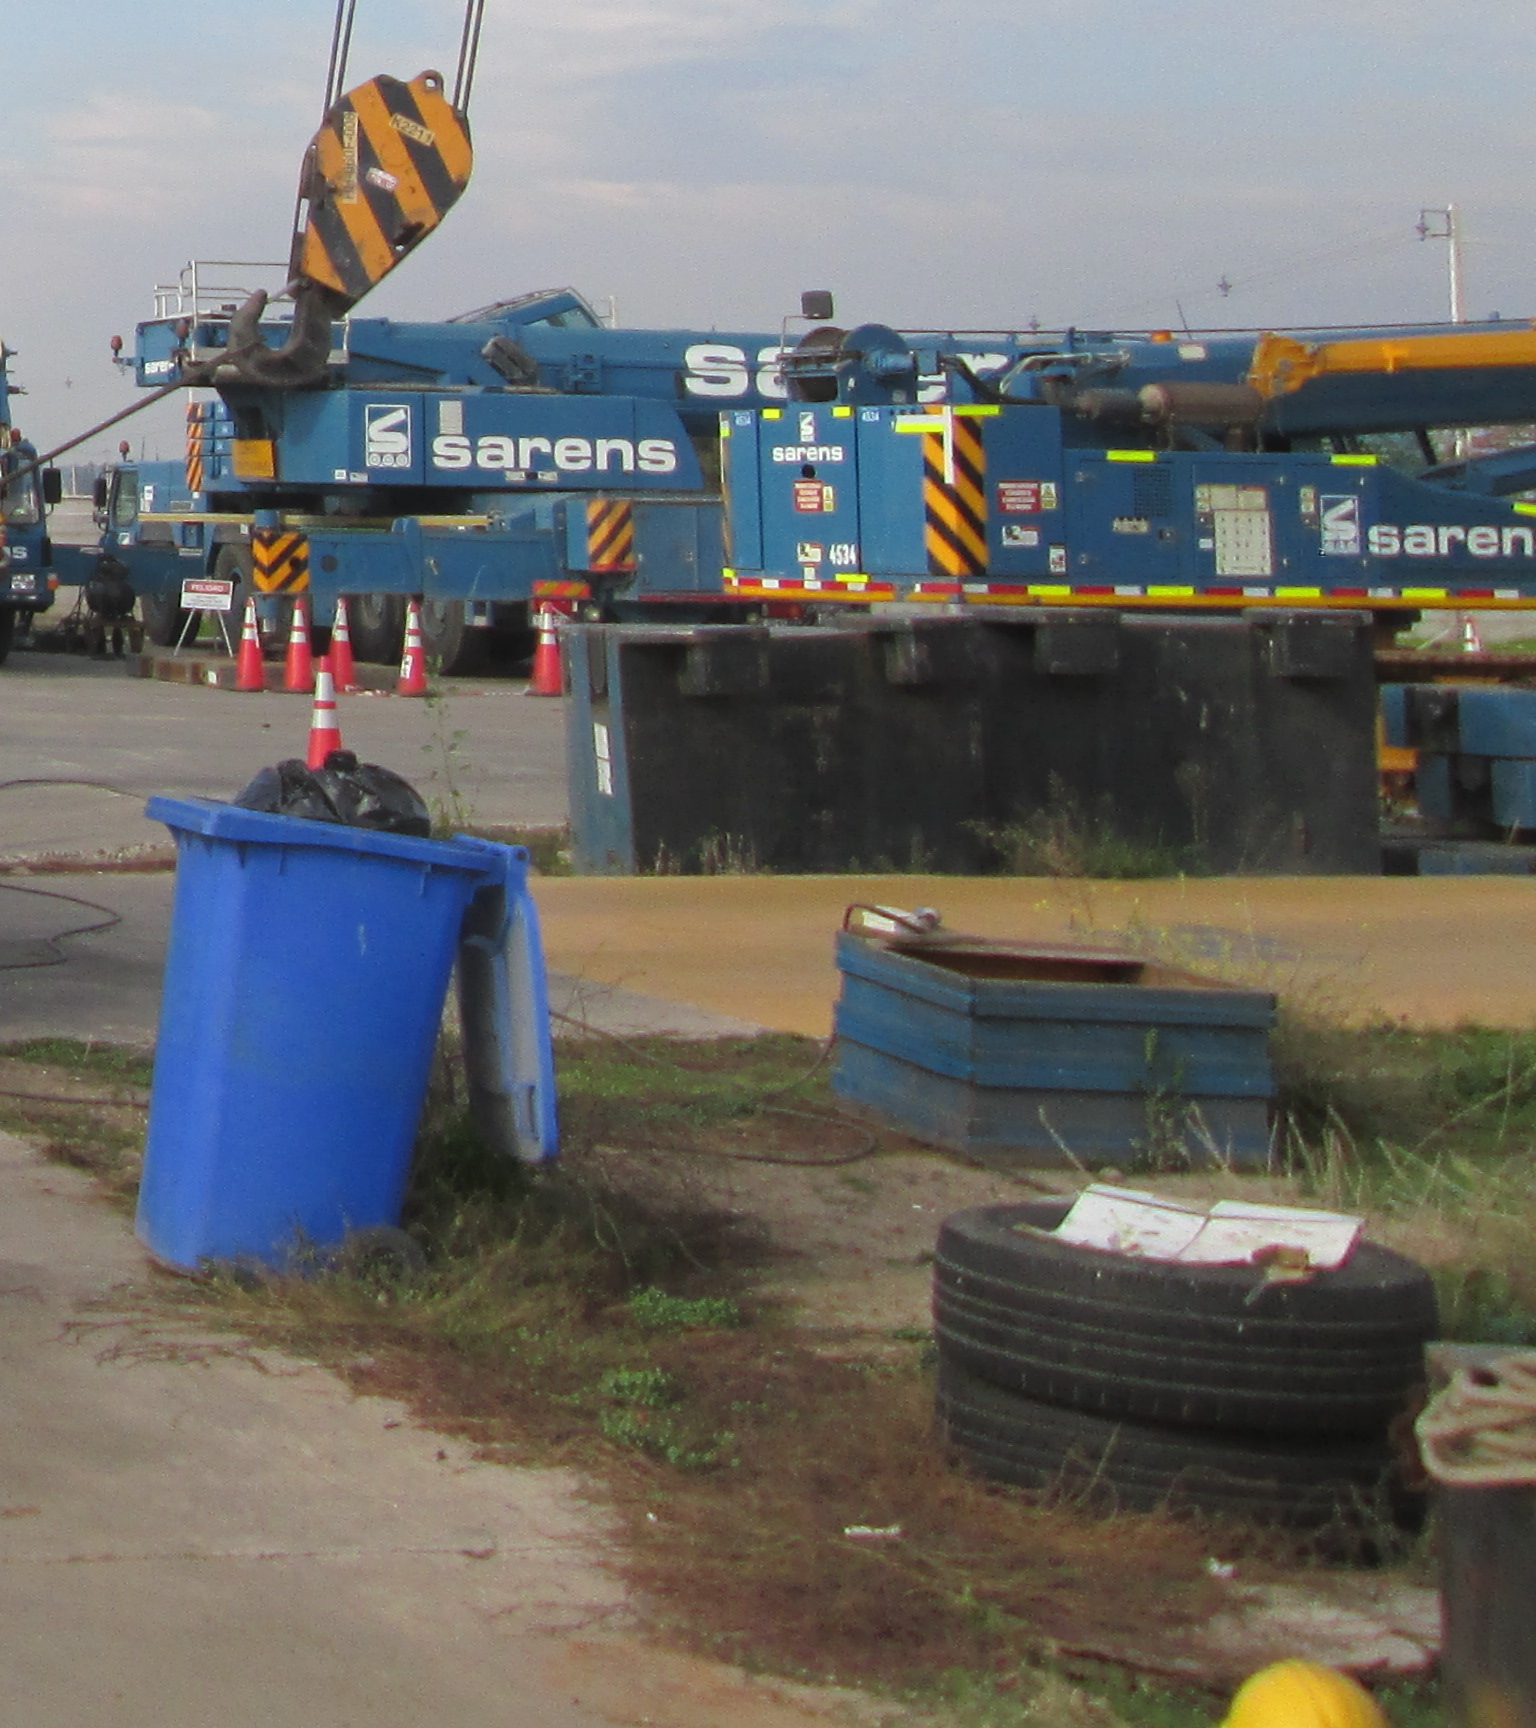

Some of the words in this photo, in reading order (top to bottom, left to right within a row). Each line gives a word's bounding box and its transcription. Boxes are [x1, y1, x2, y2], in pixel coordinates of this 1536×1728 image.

[432, 434, 676, 473] sarens
[772, 445, 844, 462] sarens
[829, 543, 856, 566] 4534
[191, 583, 224, 593] PELIGRO
